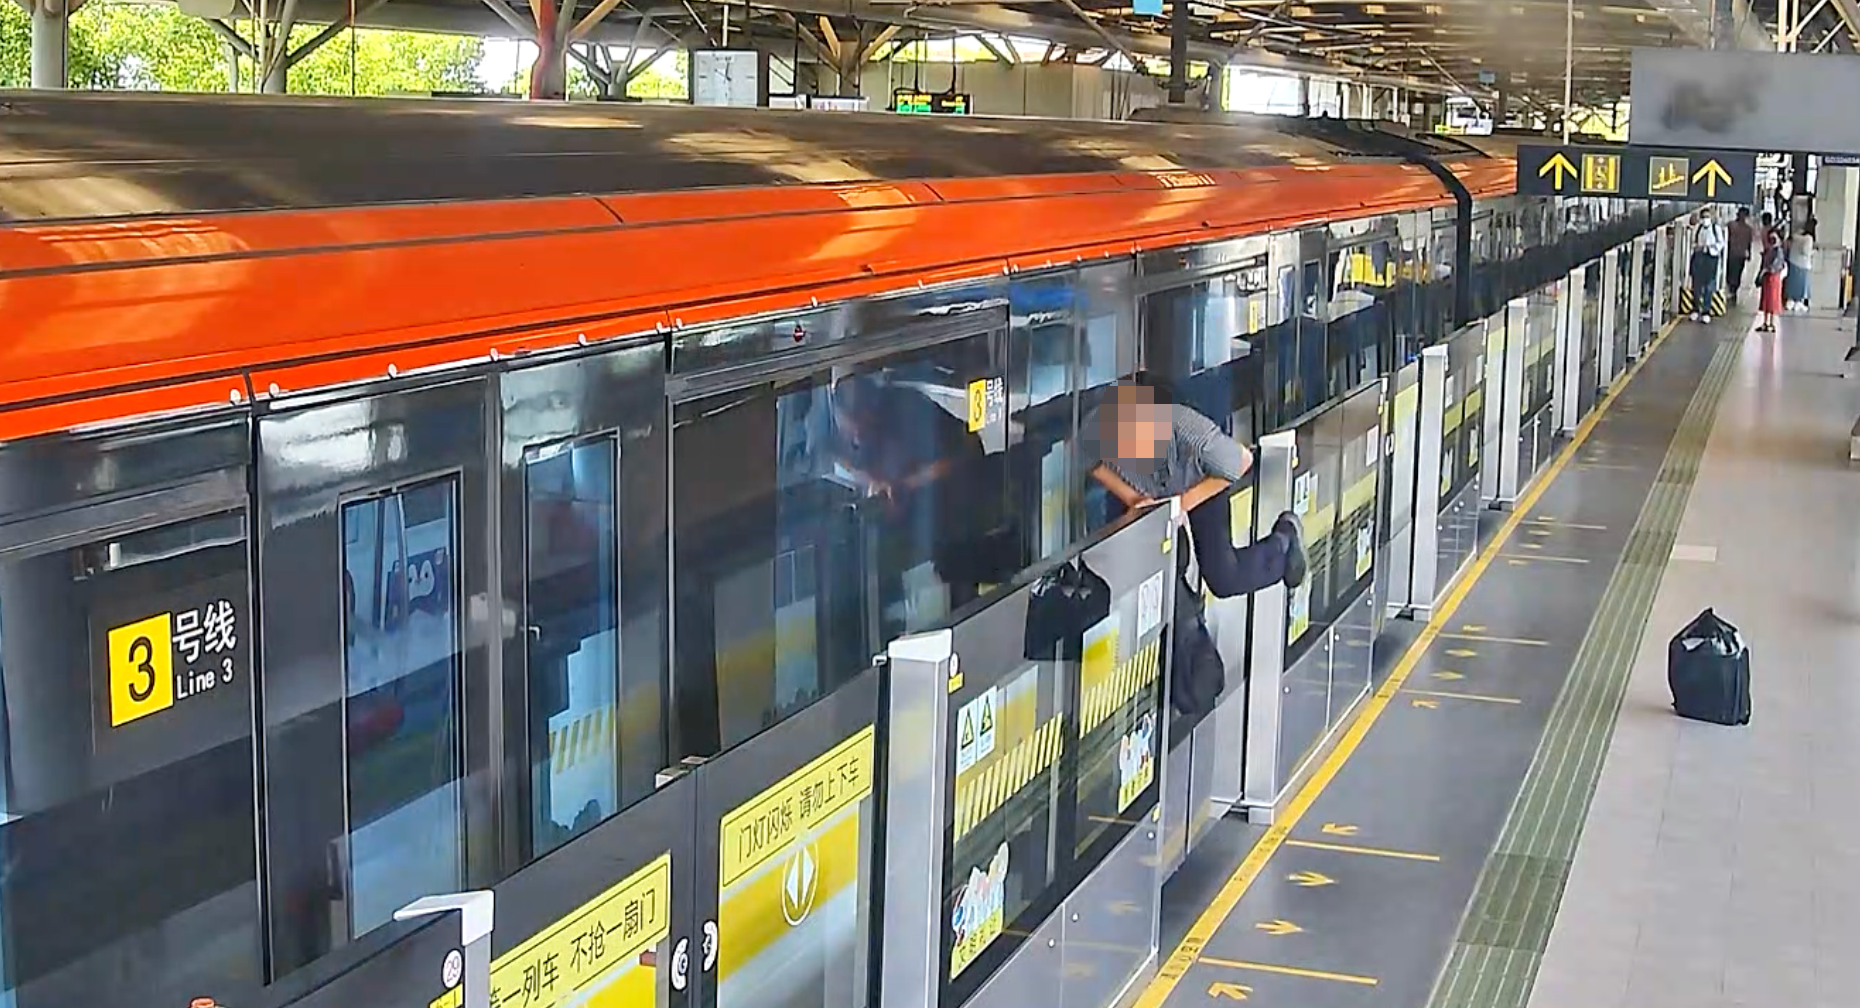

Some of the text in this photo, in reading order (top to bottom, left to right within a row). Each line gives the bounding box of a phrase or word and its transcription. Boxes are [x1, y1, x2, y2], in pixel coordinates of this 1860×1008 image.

[974, 388, 983, 423] 3
[128, 600, 237, 702] 3 号线
[176, 657, 234, 700] Line 3
[739, 755, 860, 863] 门灯闪烁 请勿上下车
[569, 888, 656, 974] 不抢一扇门
